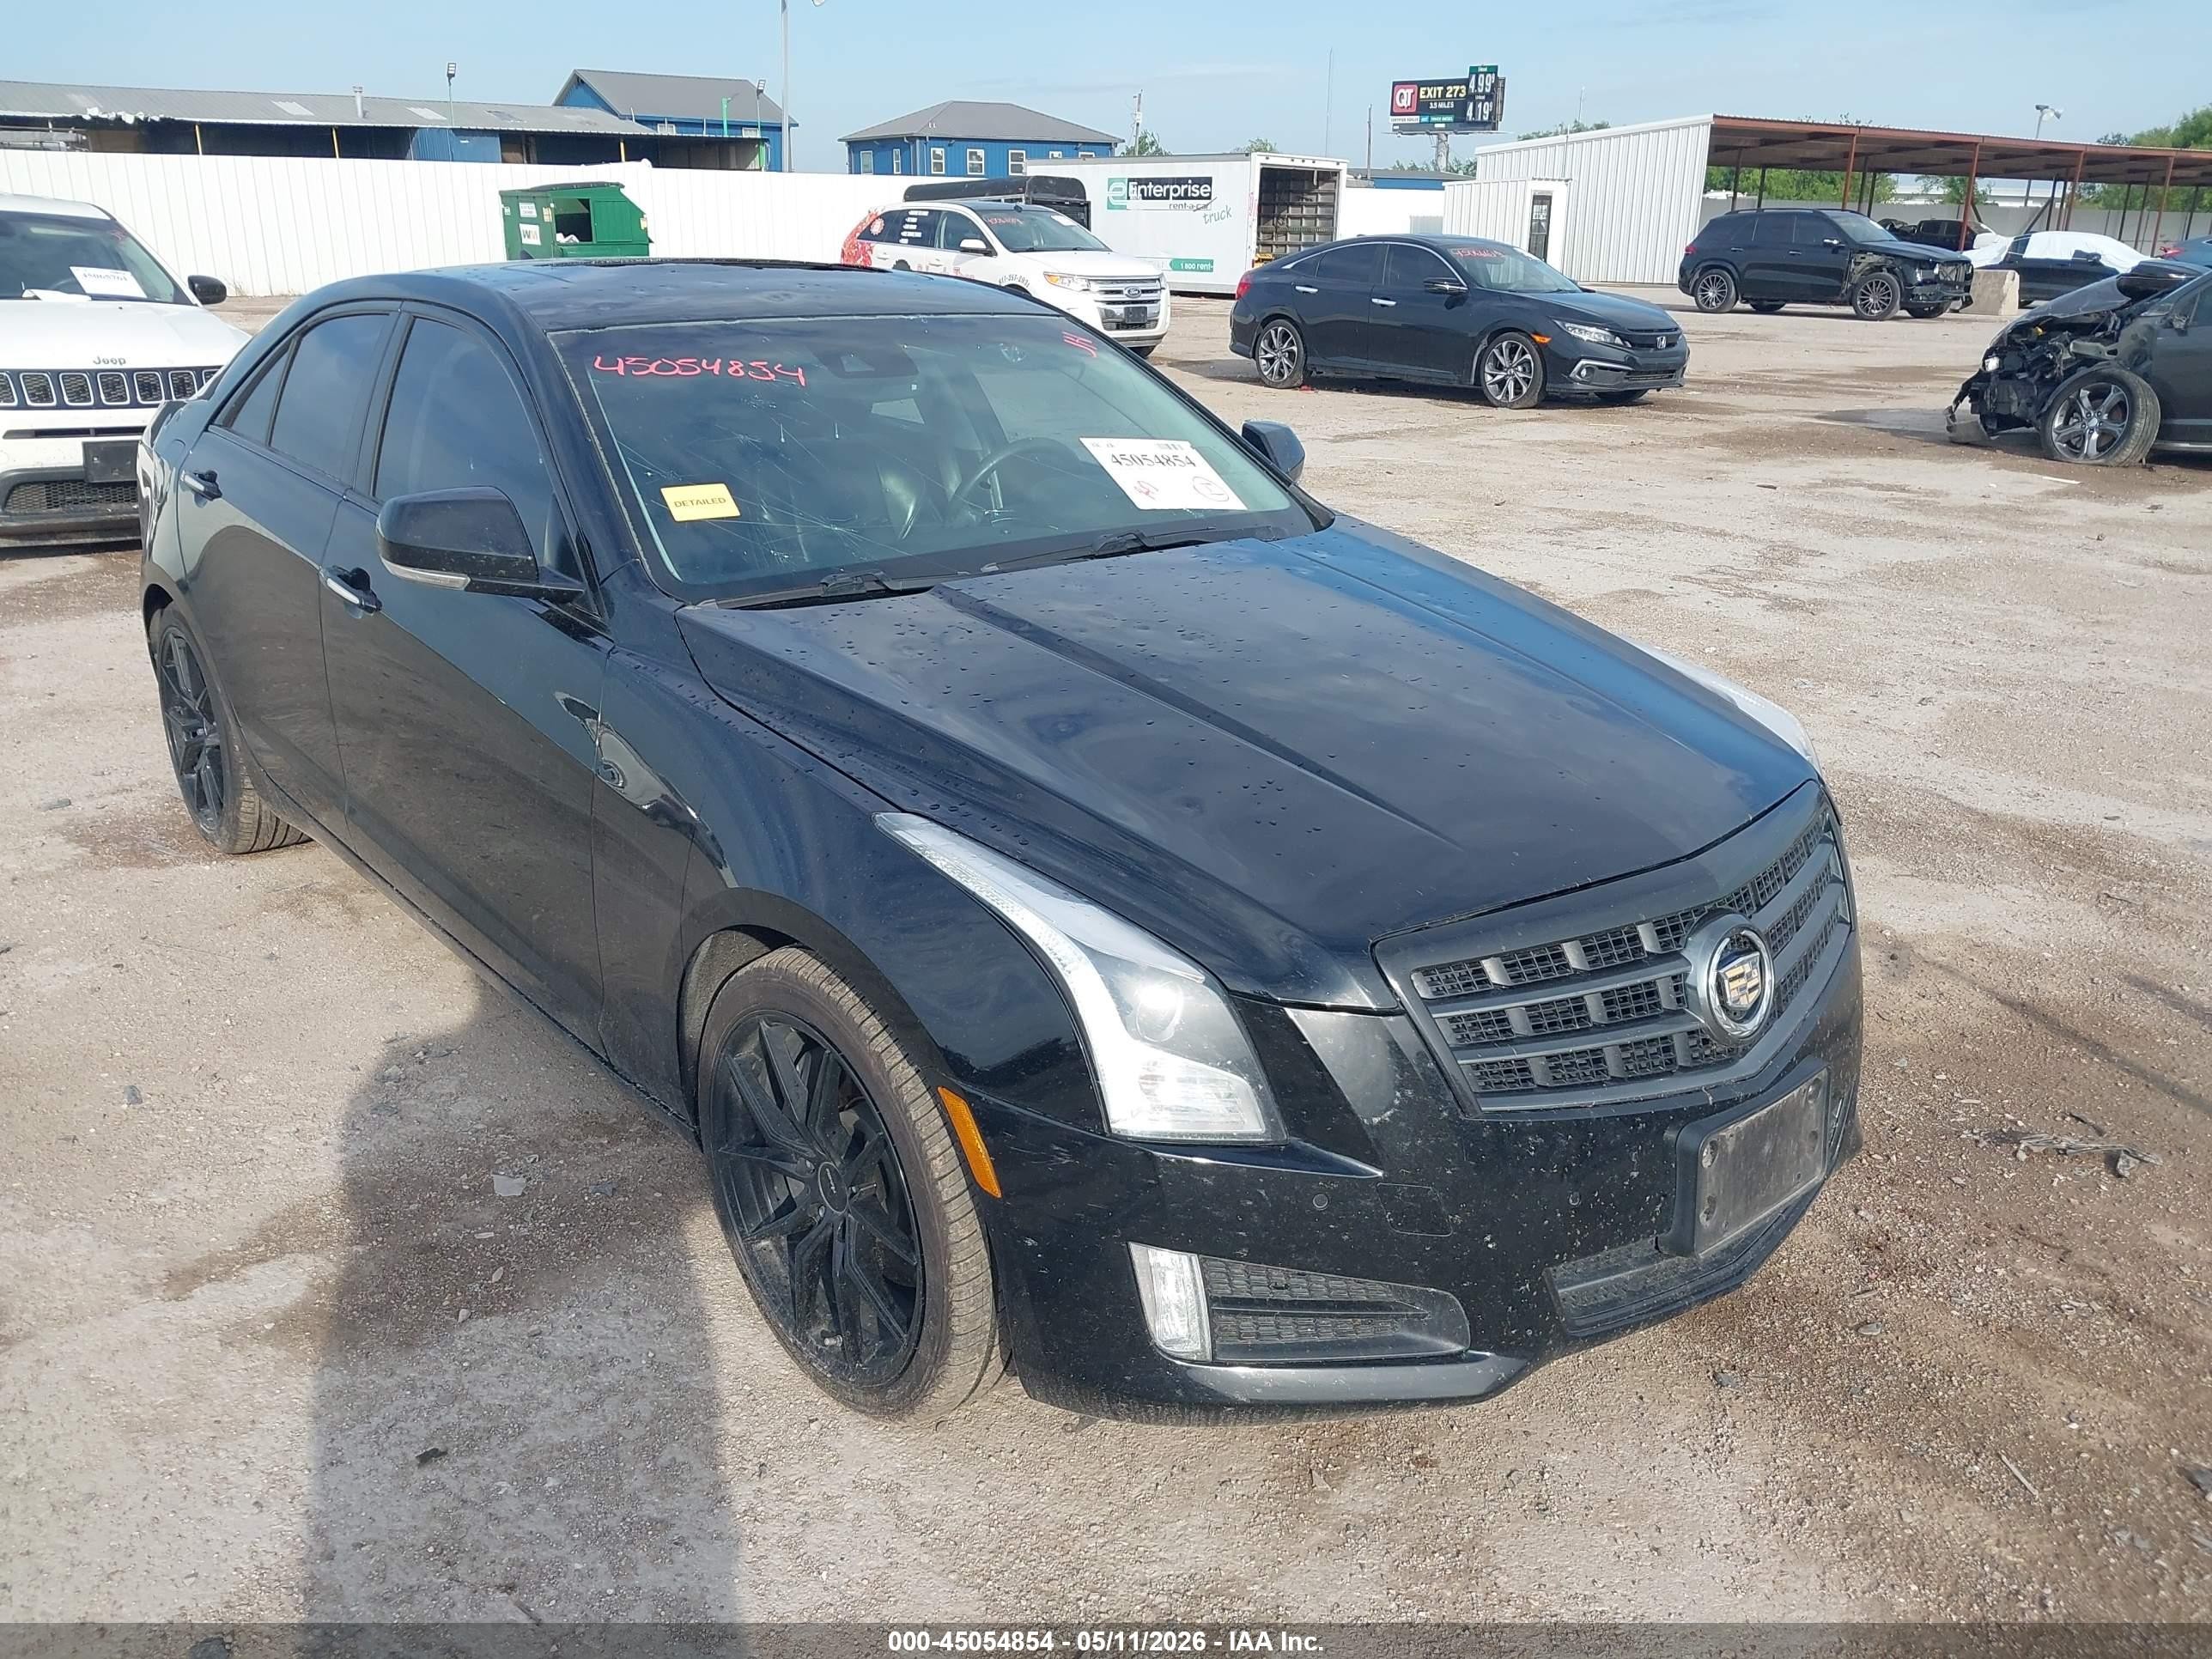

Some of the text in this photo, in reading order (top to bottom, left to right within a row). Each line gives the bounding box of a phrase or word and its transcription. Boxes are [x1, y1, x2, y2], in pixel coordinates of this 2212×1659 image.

[1395, 88, 1414, 109] QT
[1419, 87, 1443, 99] EXIT
[1445, 85, 1467, 98] 273
[1127, 179, 1212, 200] Enterprise
[1202, 205, 1233, 225] truck
[93, 355, 126, 366] Jeep
[592, 356, 806, 387] 45054854
[1110, 453, 1197, 467] 45054854
[673, 497, 726, 507] DETAILED
